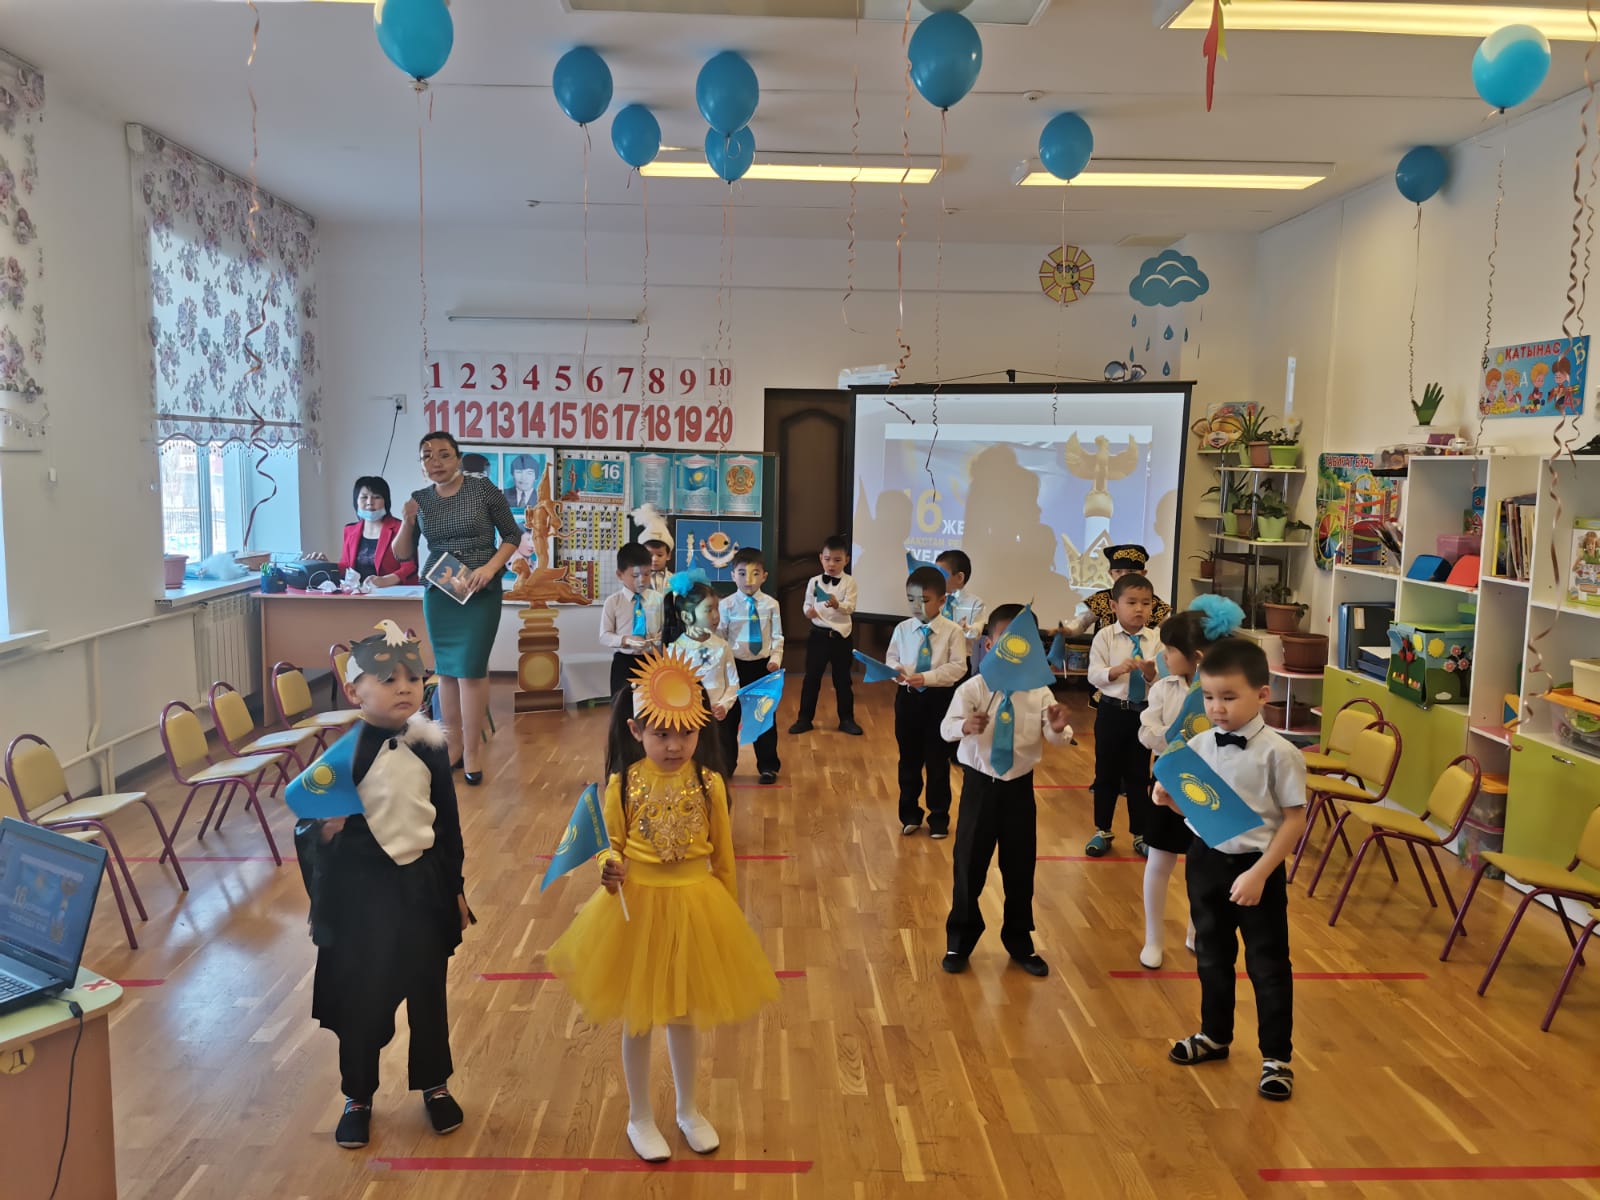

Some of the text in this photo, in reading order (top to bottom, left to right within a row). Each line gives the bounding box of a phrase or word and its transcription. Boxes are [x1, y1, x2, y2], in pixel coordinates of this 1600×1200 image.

[429, 362, 731, 395] 1 2 3 4 5 6 7 8 9 10
[424, 400, 733, 443] 11 12 13 14 15 16 17 18 19 20
[601, 463, 620, 480] 16
